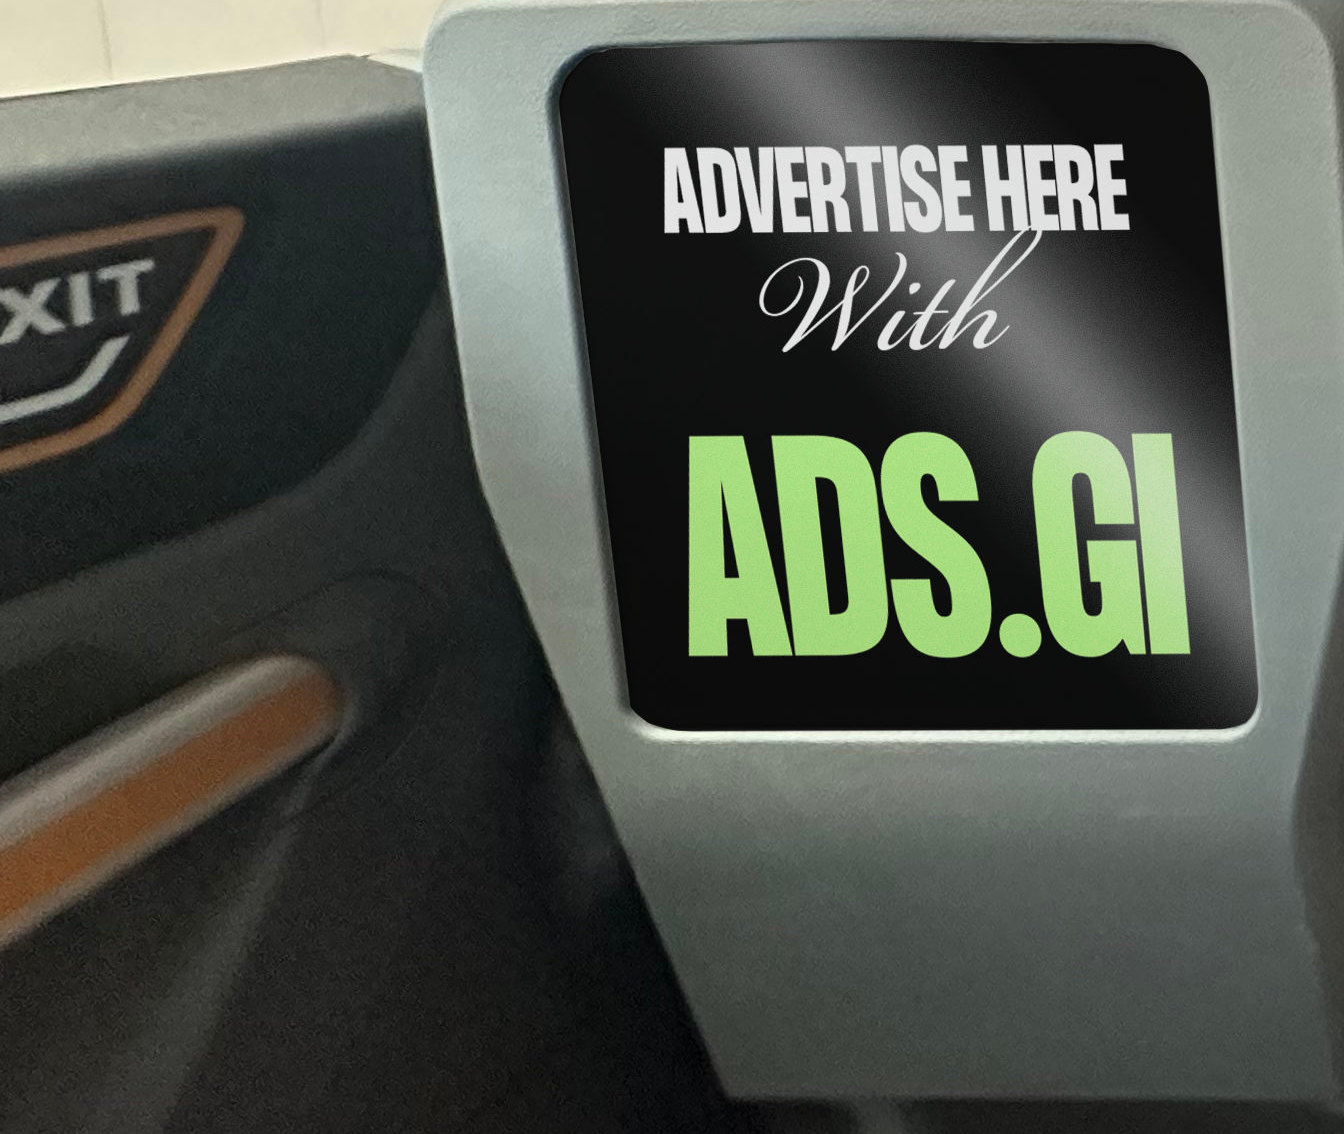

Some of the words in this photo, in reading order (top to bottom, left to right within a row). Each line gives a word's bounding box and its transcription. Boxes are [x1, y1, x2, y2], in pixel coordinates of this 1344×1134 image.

[663, 143, 975, 234] ADVERTISE
[981, 142, 1131, 232] HERE
[758, 225, 1043, 354] With
[688, 430, 1191, 659] ADS.GI
